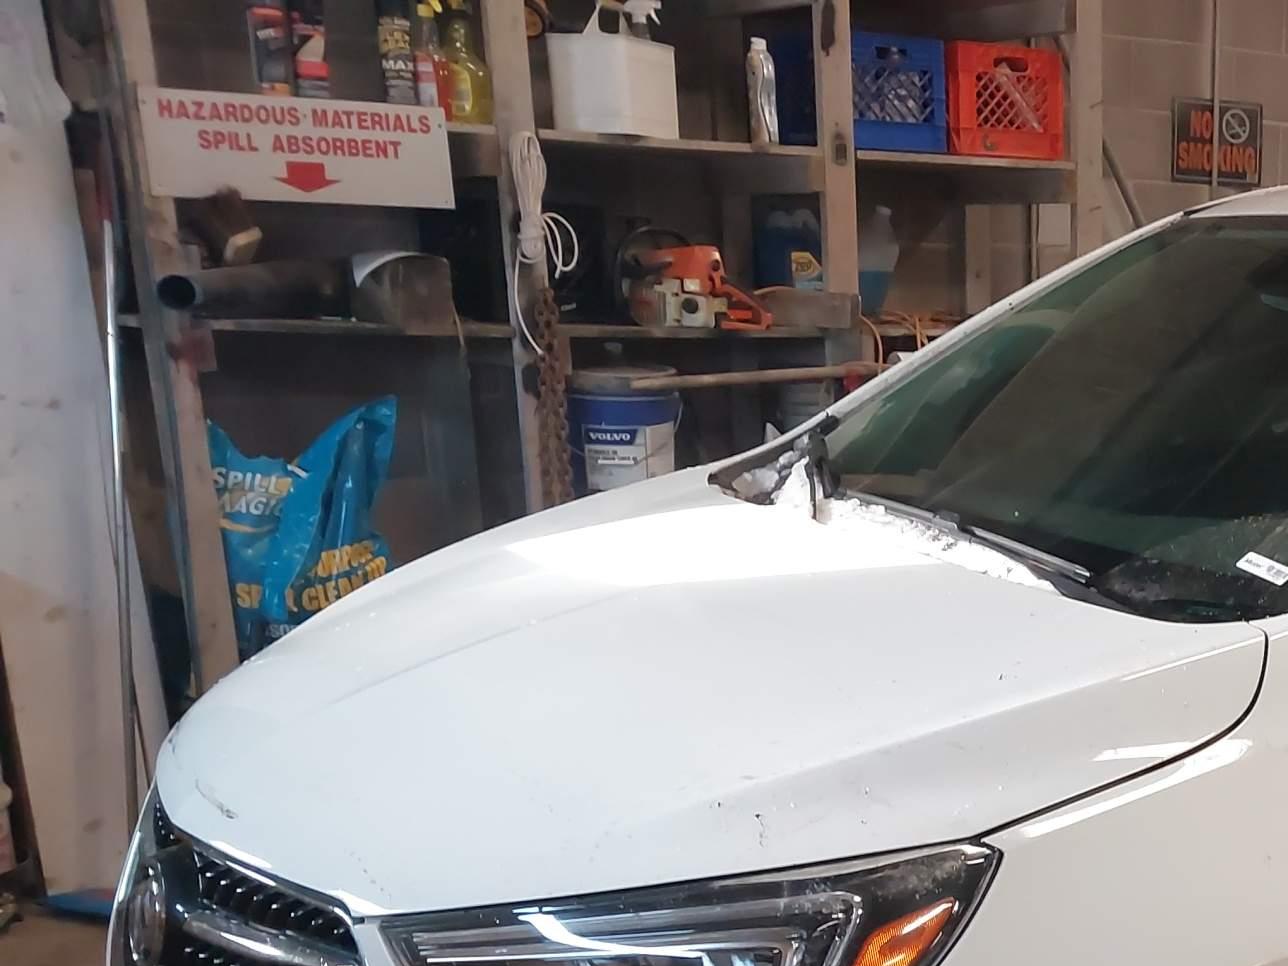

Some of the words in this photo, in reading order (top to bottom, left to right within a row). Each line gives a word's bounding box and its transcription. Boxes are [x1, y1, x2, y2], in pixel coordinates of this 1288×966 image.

[382, 59, 414, 71] MAX
[157, 98, 300, 126] HAZARDOUS
[312, 108, 431, 134] MATERIALS
[1190, 110, 1212, 139] NO
[197, 129, 259, 152] SPILL
[272, 137, 402, 160] ABSORBENT
[588, 431, 631, 441] VOLVO
[213, 467, 282, 495] SPILL
